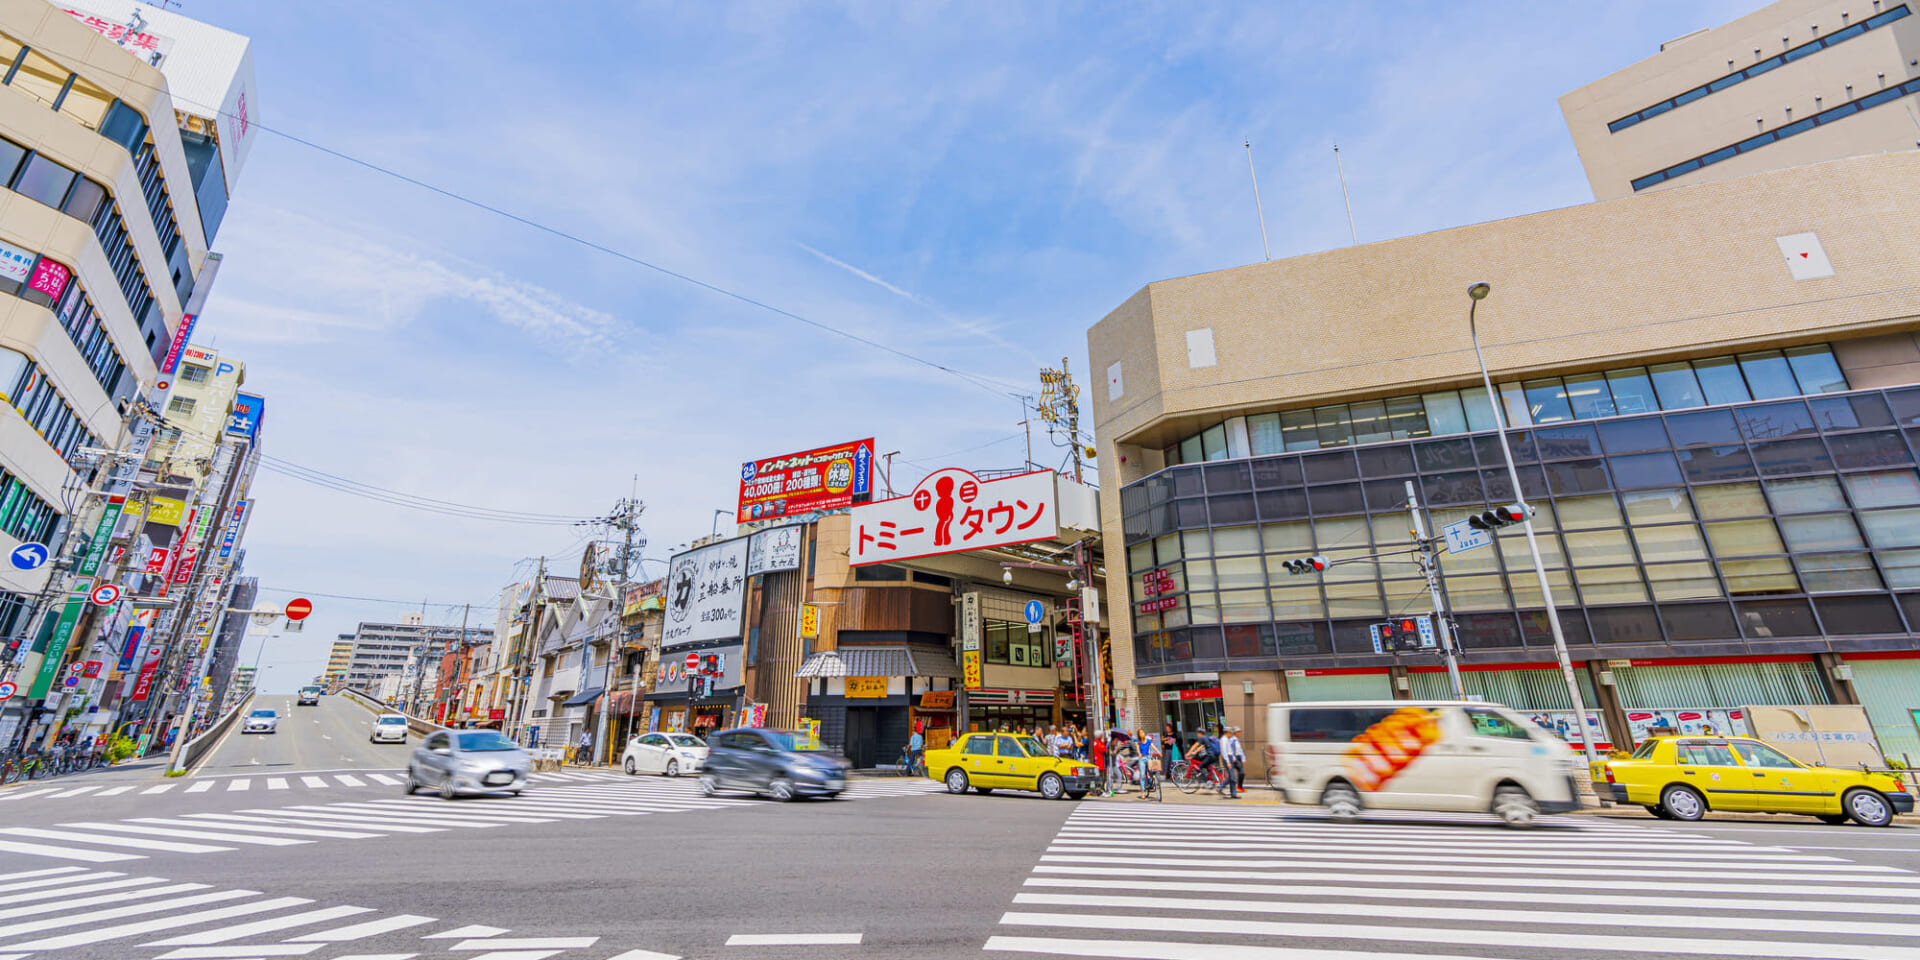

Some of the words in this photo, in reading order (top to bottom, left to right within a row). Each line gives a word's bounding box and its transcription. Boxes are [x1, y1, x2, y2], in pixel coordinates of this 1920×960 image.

[215, 362, 234, 377] P
[758, 454, 813, 474] インターネット
[828, 468, 850, 481] 休憩
[859, 521, 924, 555] トミー
[960, 500, 1044, 541] タウン
